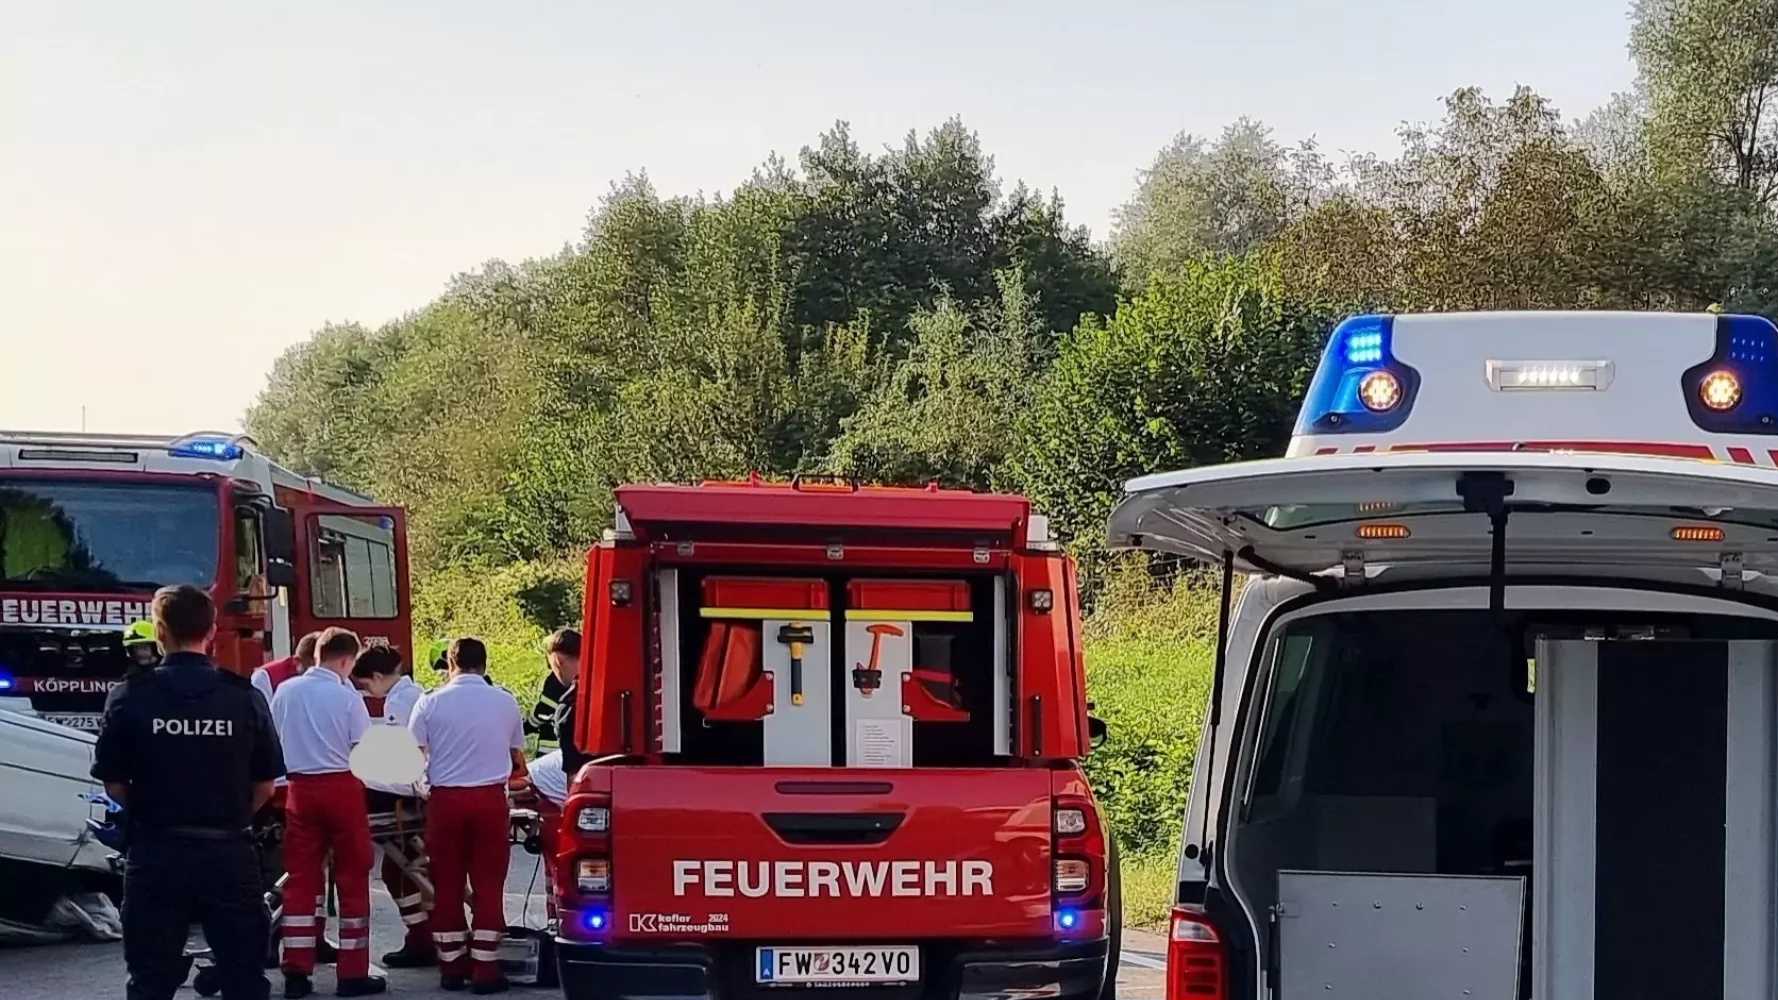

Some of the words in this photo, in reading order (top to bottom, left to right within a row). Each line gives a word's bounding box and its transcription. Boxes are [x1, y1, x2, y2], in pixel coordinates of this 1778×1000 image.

[152, 718, 233, 736] POLIZEI
[672, 860, 994, 897] FEUERWEHR
[658, 923, 729, 933] fahrzeugbau
[778, 952, 812, 975] FW
